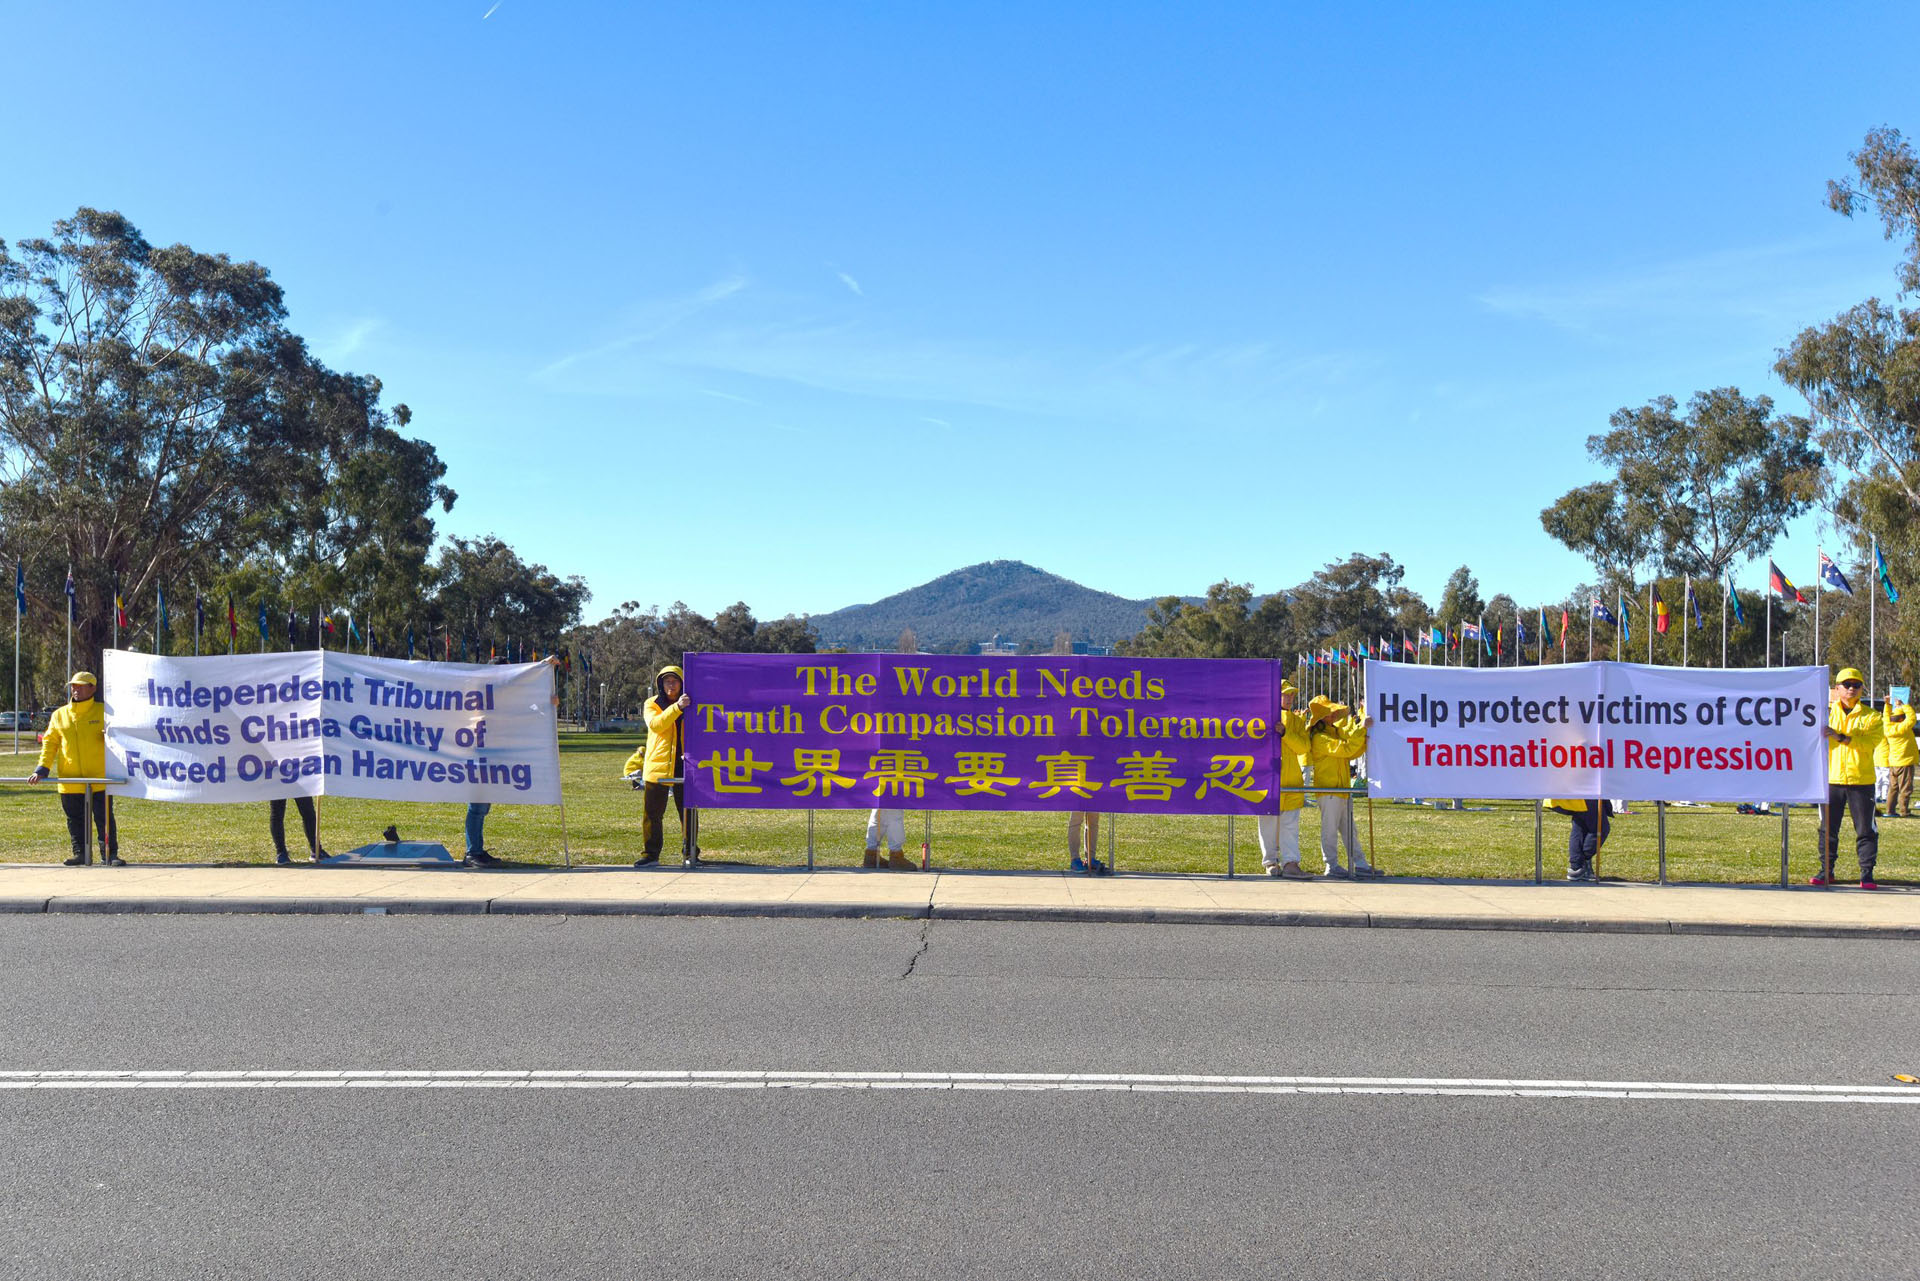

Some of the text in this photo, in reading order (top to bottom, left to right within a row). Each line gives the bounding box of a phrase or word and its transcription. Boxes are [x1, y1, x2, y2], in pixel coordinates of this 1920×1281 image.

[148, 675, 495, 713] Independent Tribunal
[796, 666, 1165, 701] The World Needs
[696, 704, 1266, 741] Truth Compassion Tolerance
[1379, 693, 1816, 728] Help protect victims of CCP's
[156, 715, 487, 750] finds China Guilty of
[125, 750, 532, 790] Forced Organ Harvesting
[1407, 737, 1793, 774] Transnational Repression
[698, 748, 1269, 803] 世界需要真善忍
